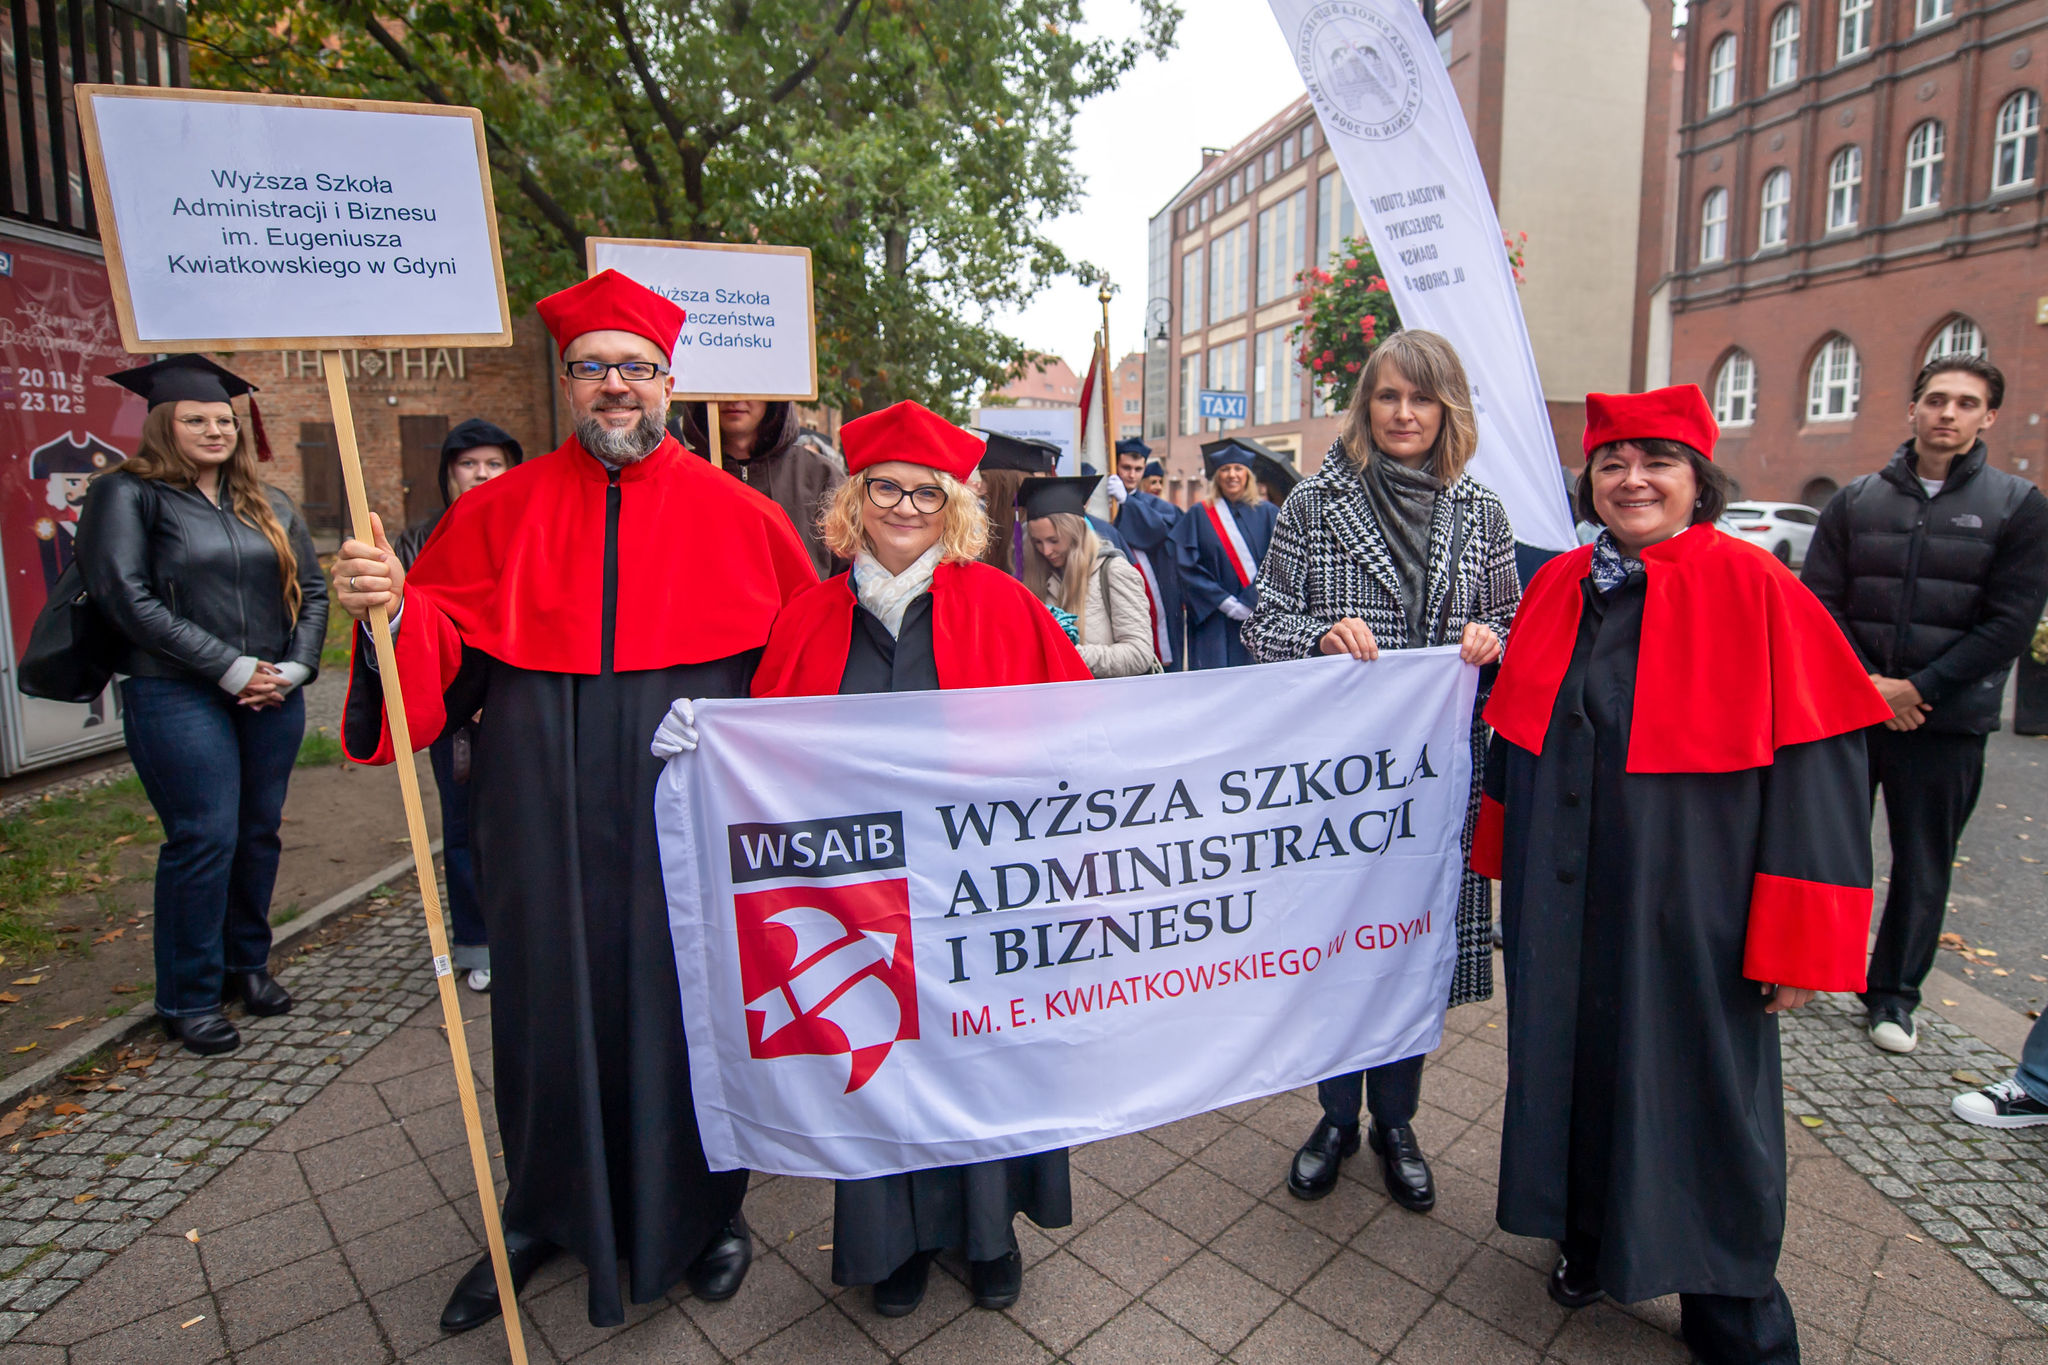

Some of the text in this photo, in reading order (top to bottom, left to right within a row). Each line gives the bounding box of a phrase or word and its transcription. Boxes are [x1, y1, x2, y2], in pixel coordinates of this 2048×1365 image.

[211, 169, 393, 194] Wyższa Szkoła
[172, 197, 437, 224] Administracji i Biznesu
[221, 227, 403, 251] im. Eugeniusza
[168, 254, 457, 279] Kwiatkowskiego w Gdyni
[715, 288, 771, 305] Szkoła
[679, 331, 772, 348] w Gdańsku
[376, 348, 465, 379] THAI
[17, 367, 66, 390] 20.11
[20, 391, 72, 414] 23.12
[1202, 396, 1244, 417] TAXI
[935, 742, 1438, 851] WYŻSZA SZKOŁA
[739, 822, 896, 870] WSAiB
[943, 798, 1416, 919] ADMINISTRACJI
[946, 889, 1257, 984] I BIZNESU
[951, 910, 1432, 1038] IM. E. KWIATKOWSKIEGO W GDYNI
